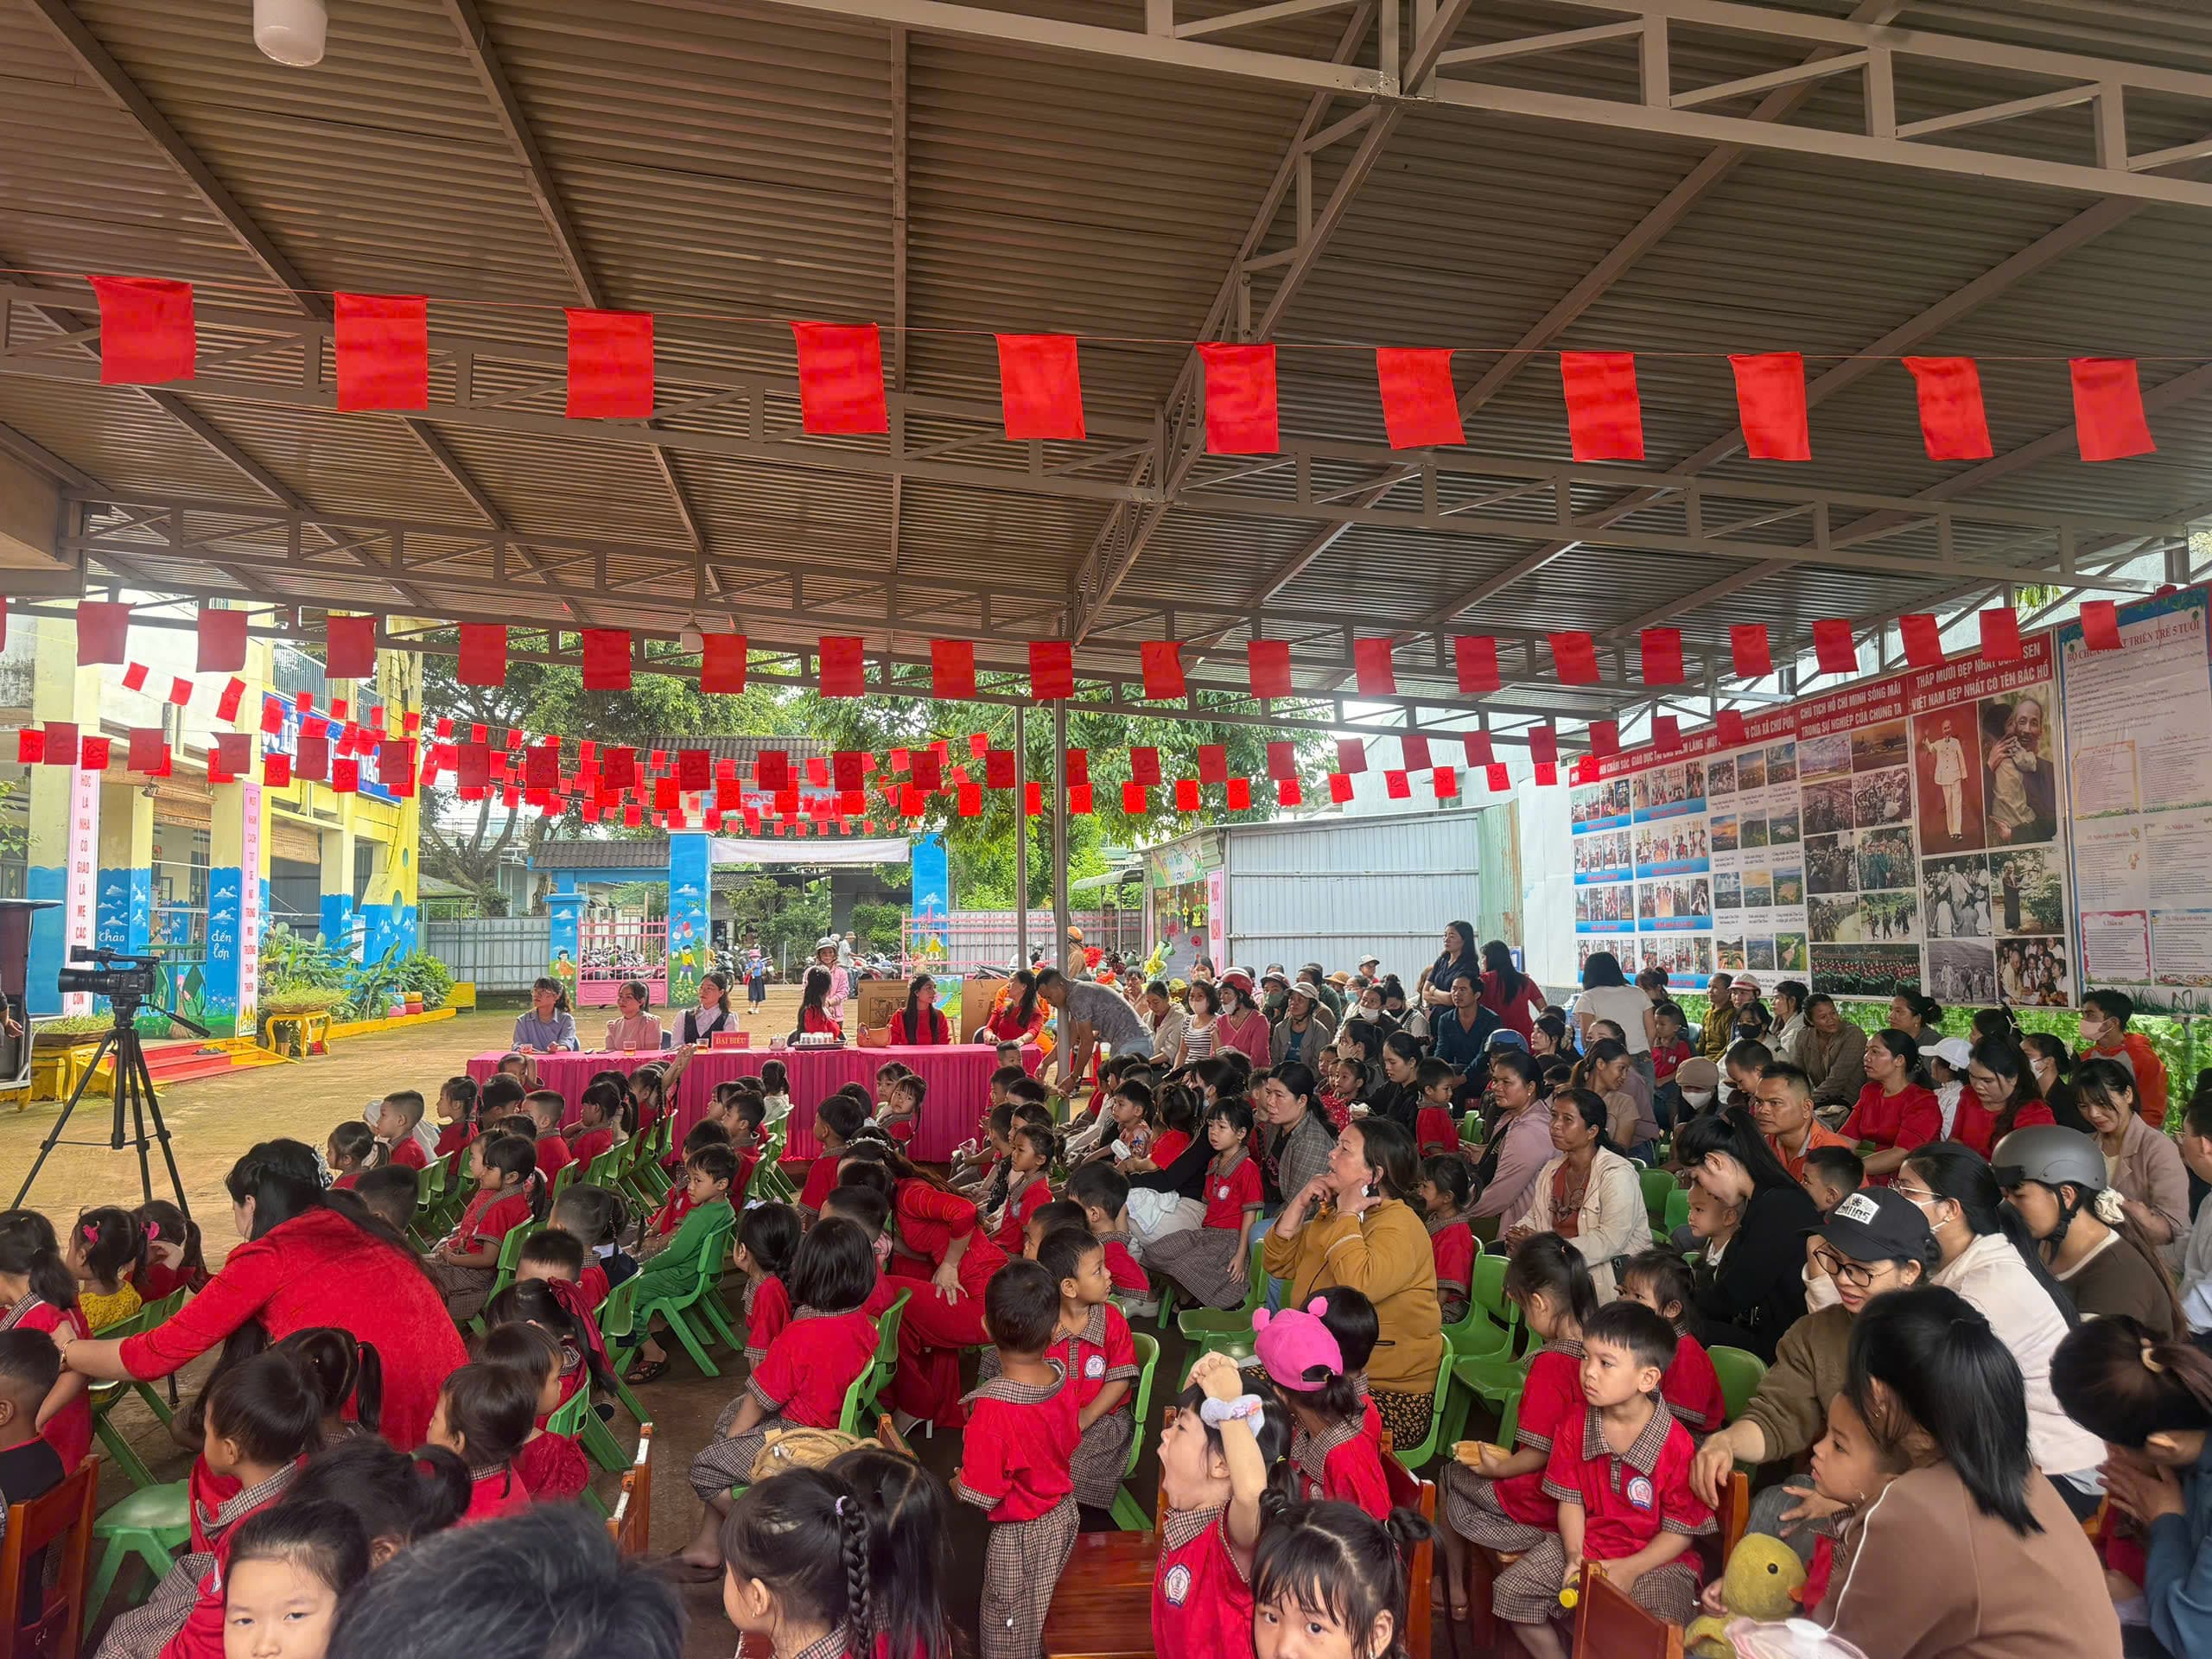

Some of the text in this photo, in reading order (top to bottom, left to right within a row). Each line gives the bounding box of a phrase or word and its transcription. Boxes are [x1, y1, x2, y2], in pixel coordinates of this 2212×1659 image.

[1916, 671, 1935, 689] THÁP
[1936, 664, 1956, 683] MƯỜI
[1957, 662, 1973, 678] ĐẸP
[2023, 642, 2041, 659] SEN
[1849, 692, 1866, 706] MINH
[1887, 681, 1902, 697] MÃI
[1911, 694, 1927, 711] VIỆT
[1929, 690, 1945, 707] NAM
[1964, 677, 1985, 697] NHẤT
[1986, 674, 1999, 691] CÓ
[2000, 671, 2016, 688] TÊN
[2018, 664, 2035, 683] BÁC
[2037, 658, 2050, 679] HỒ
[1869, 704, 1892, 721] CHÚNG
[1893, 702, 1902, 715] TA
